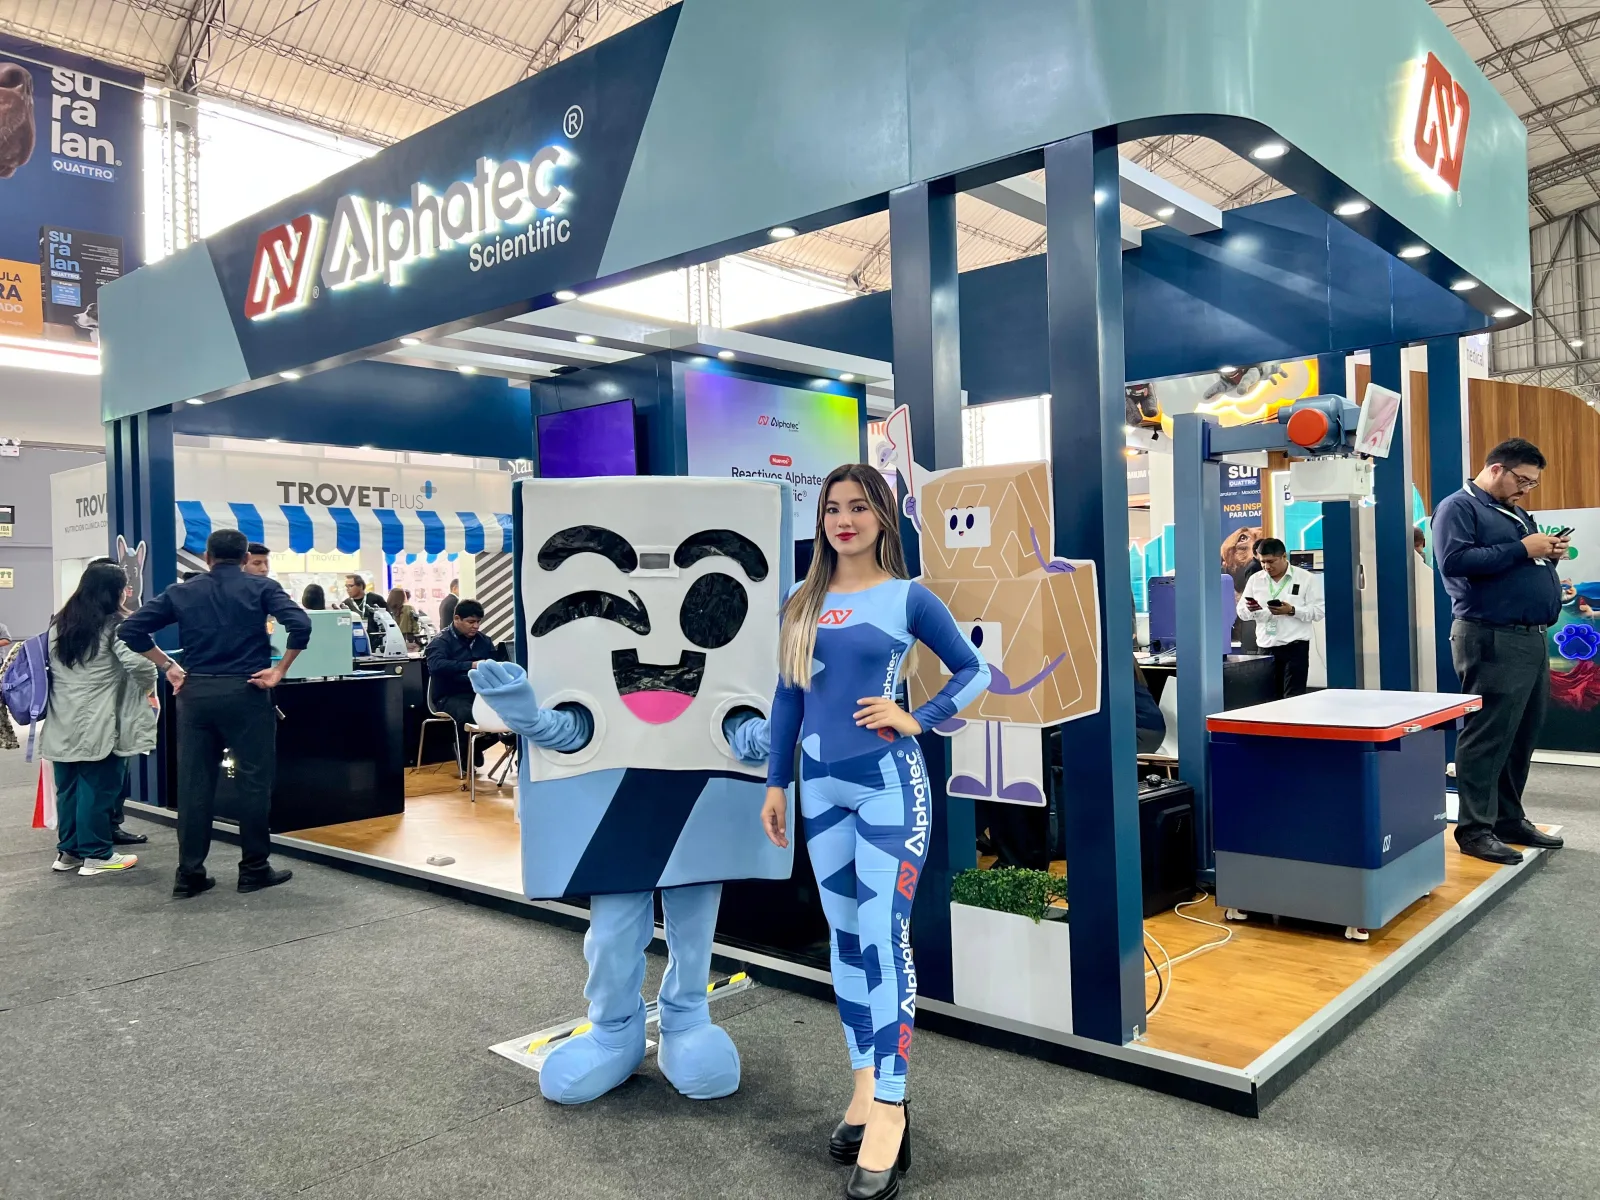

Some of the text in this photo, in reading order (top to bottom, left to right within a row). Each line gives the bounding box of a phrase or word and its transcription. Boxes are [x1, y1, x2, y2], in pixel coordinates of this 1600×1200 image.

[51, 67, 100, 100] su
[51, 93, 97, 127] ra
[52, 159, 113, 180] QUATTRO
[48, 230, 72, 245] su
[468, 214, 571, 272] Scientific
[49, 243, 71, 257] ra
[731, 466, 783, 481] Reactivos
[276, 480, 424, 510] TROVET PLUS
[76, 494, 108, 518] TROV
[1223, 504, 1241, 512] NOS
[1228, 511, 1248, 519] PARA
